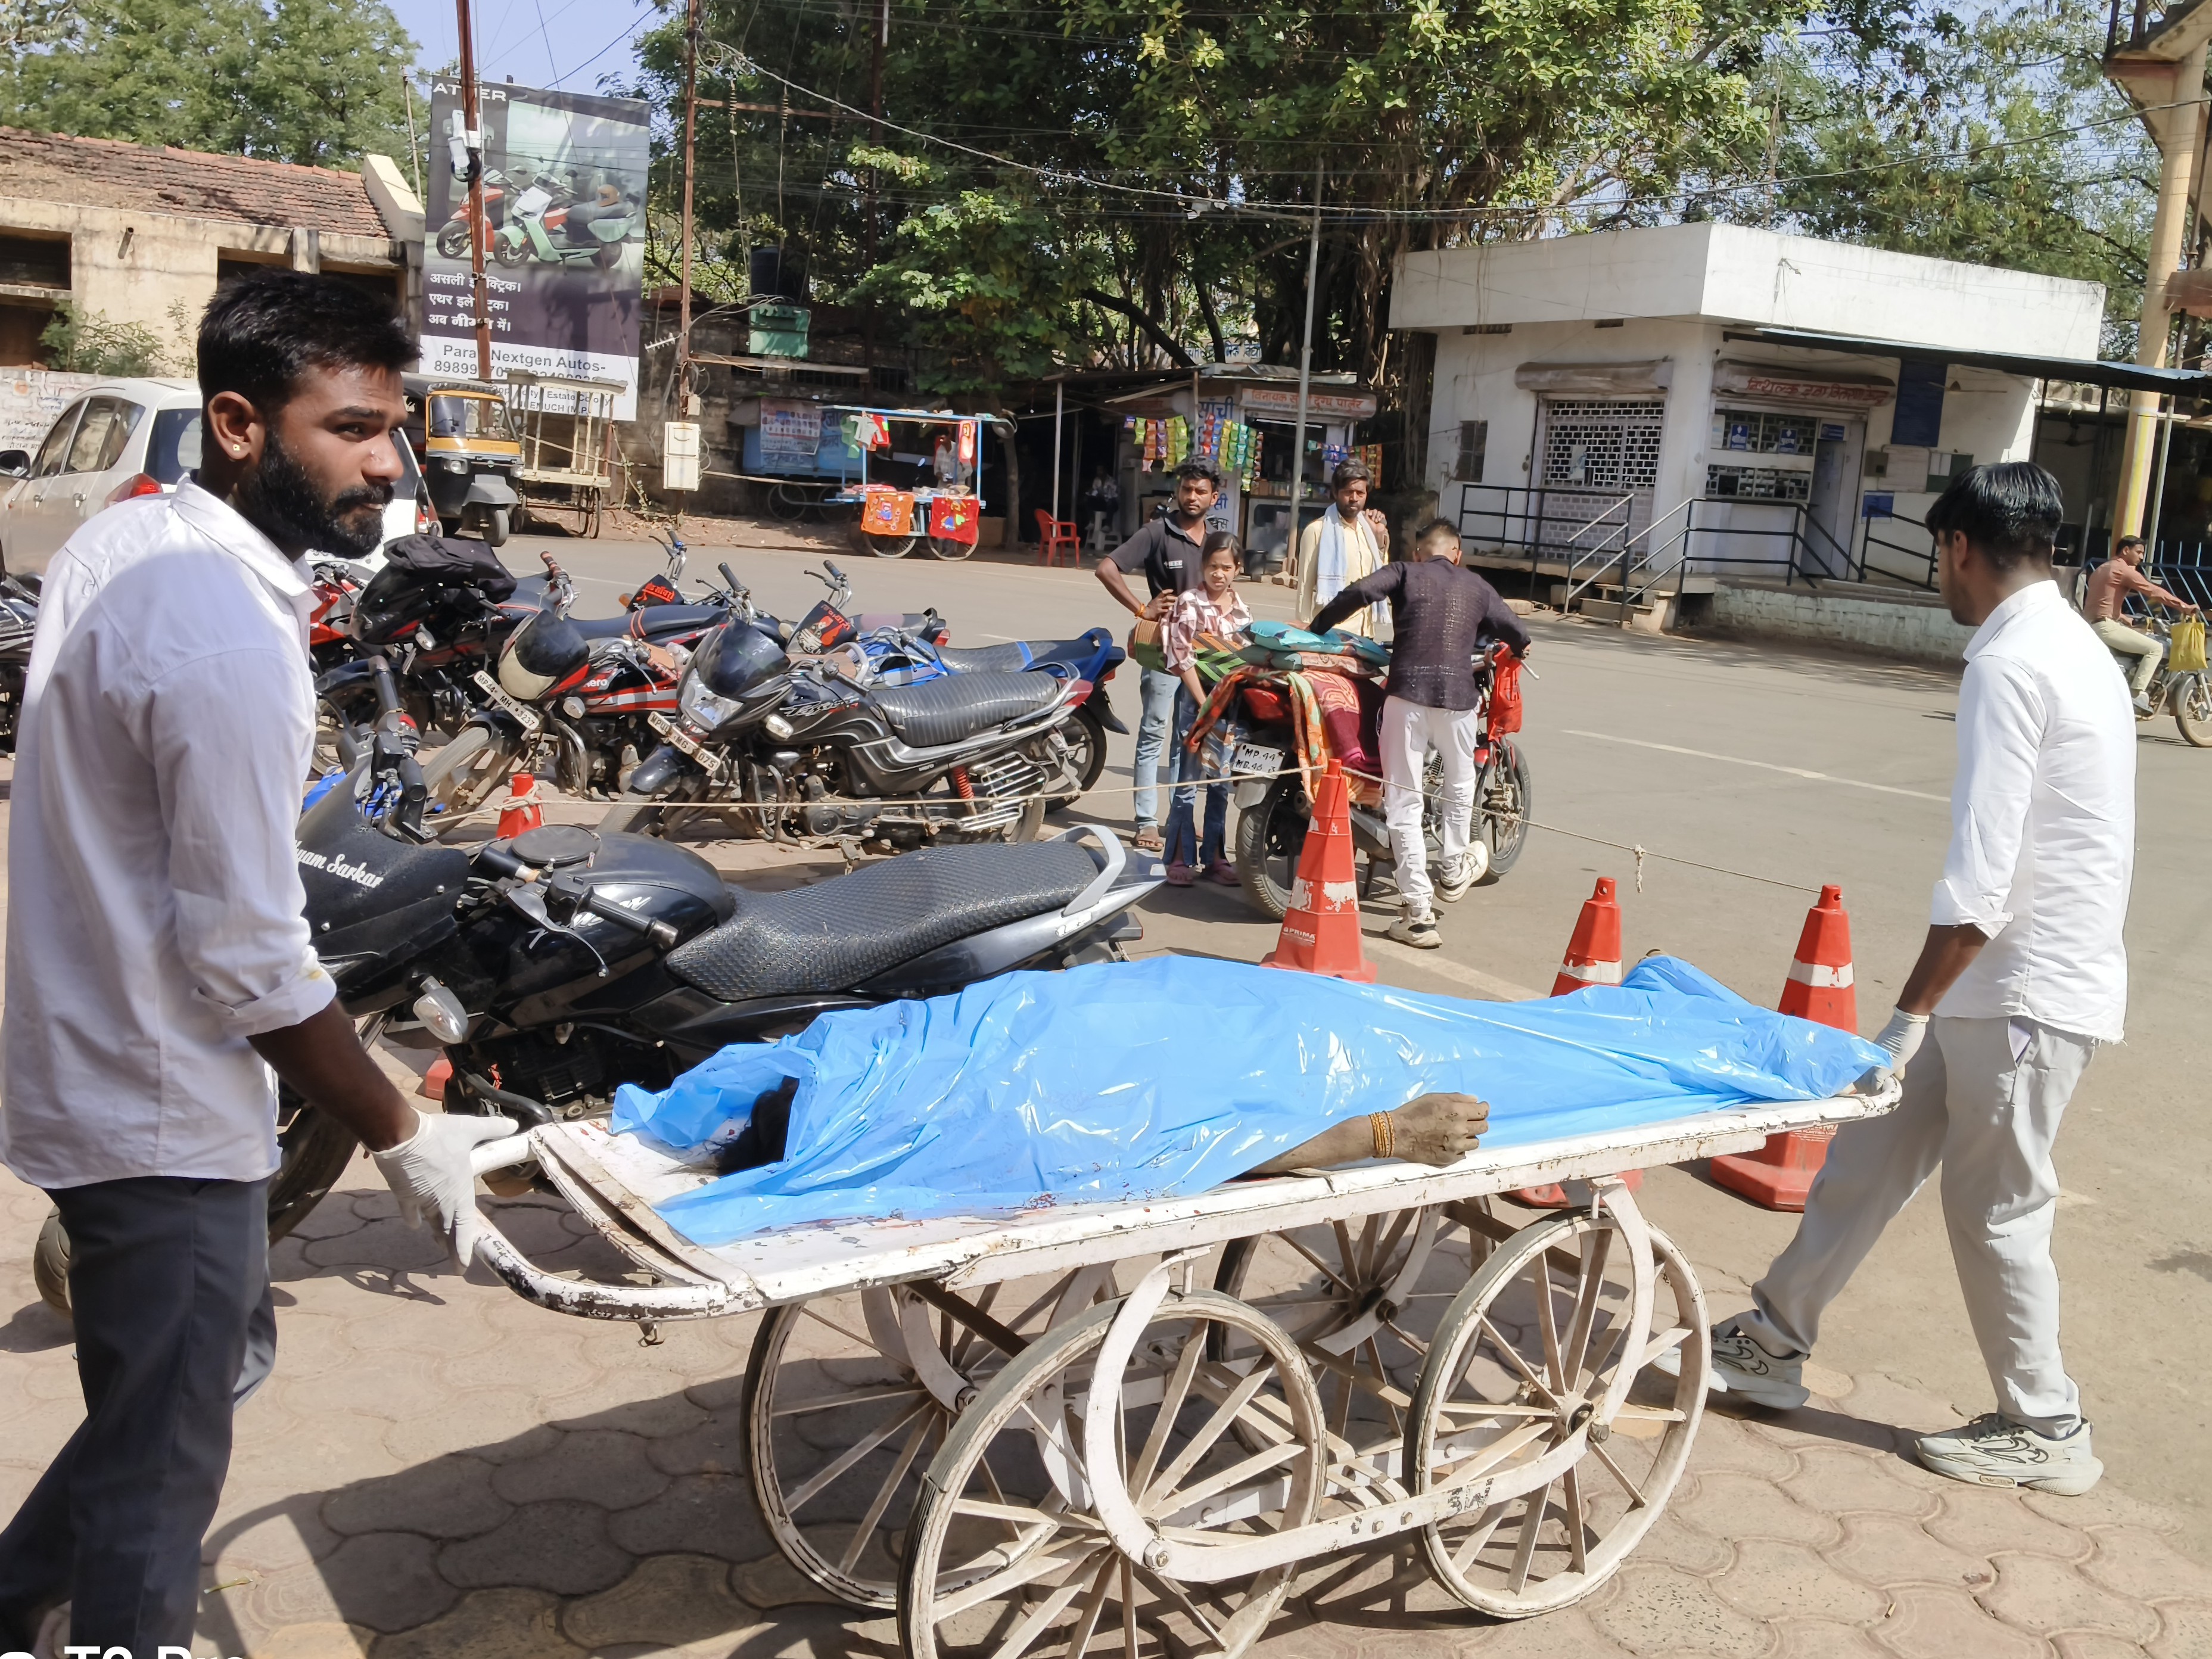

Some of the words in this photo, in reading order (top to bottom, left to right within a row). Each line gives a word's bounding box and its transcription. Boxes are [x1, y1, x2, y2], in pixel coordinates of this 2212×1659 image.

[443, 344, 477, 358] Para
[491, 349, 552, 368] Nextgen
[579, 394, 611, 406] Cooy
[499, 695, 512, 708] MH
[326, 854, 384, 888] Sarkar
[1289, 927, 1316, 939] PRIMA
